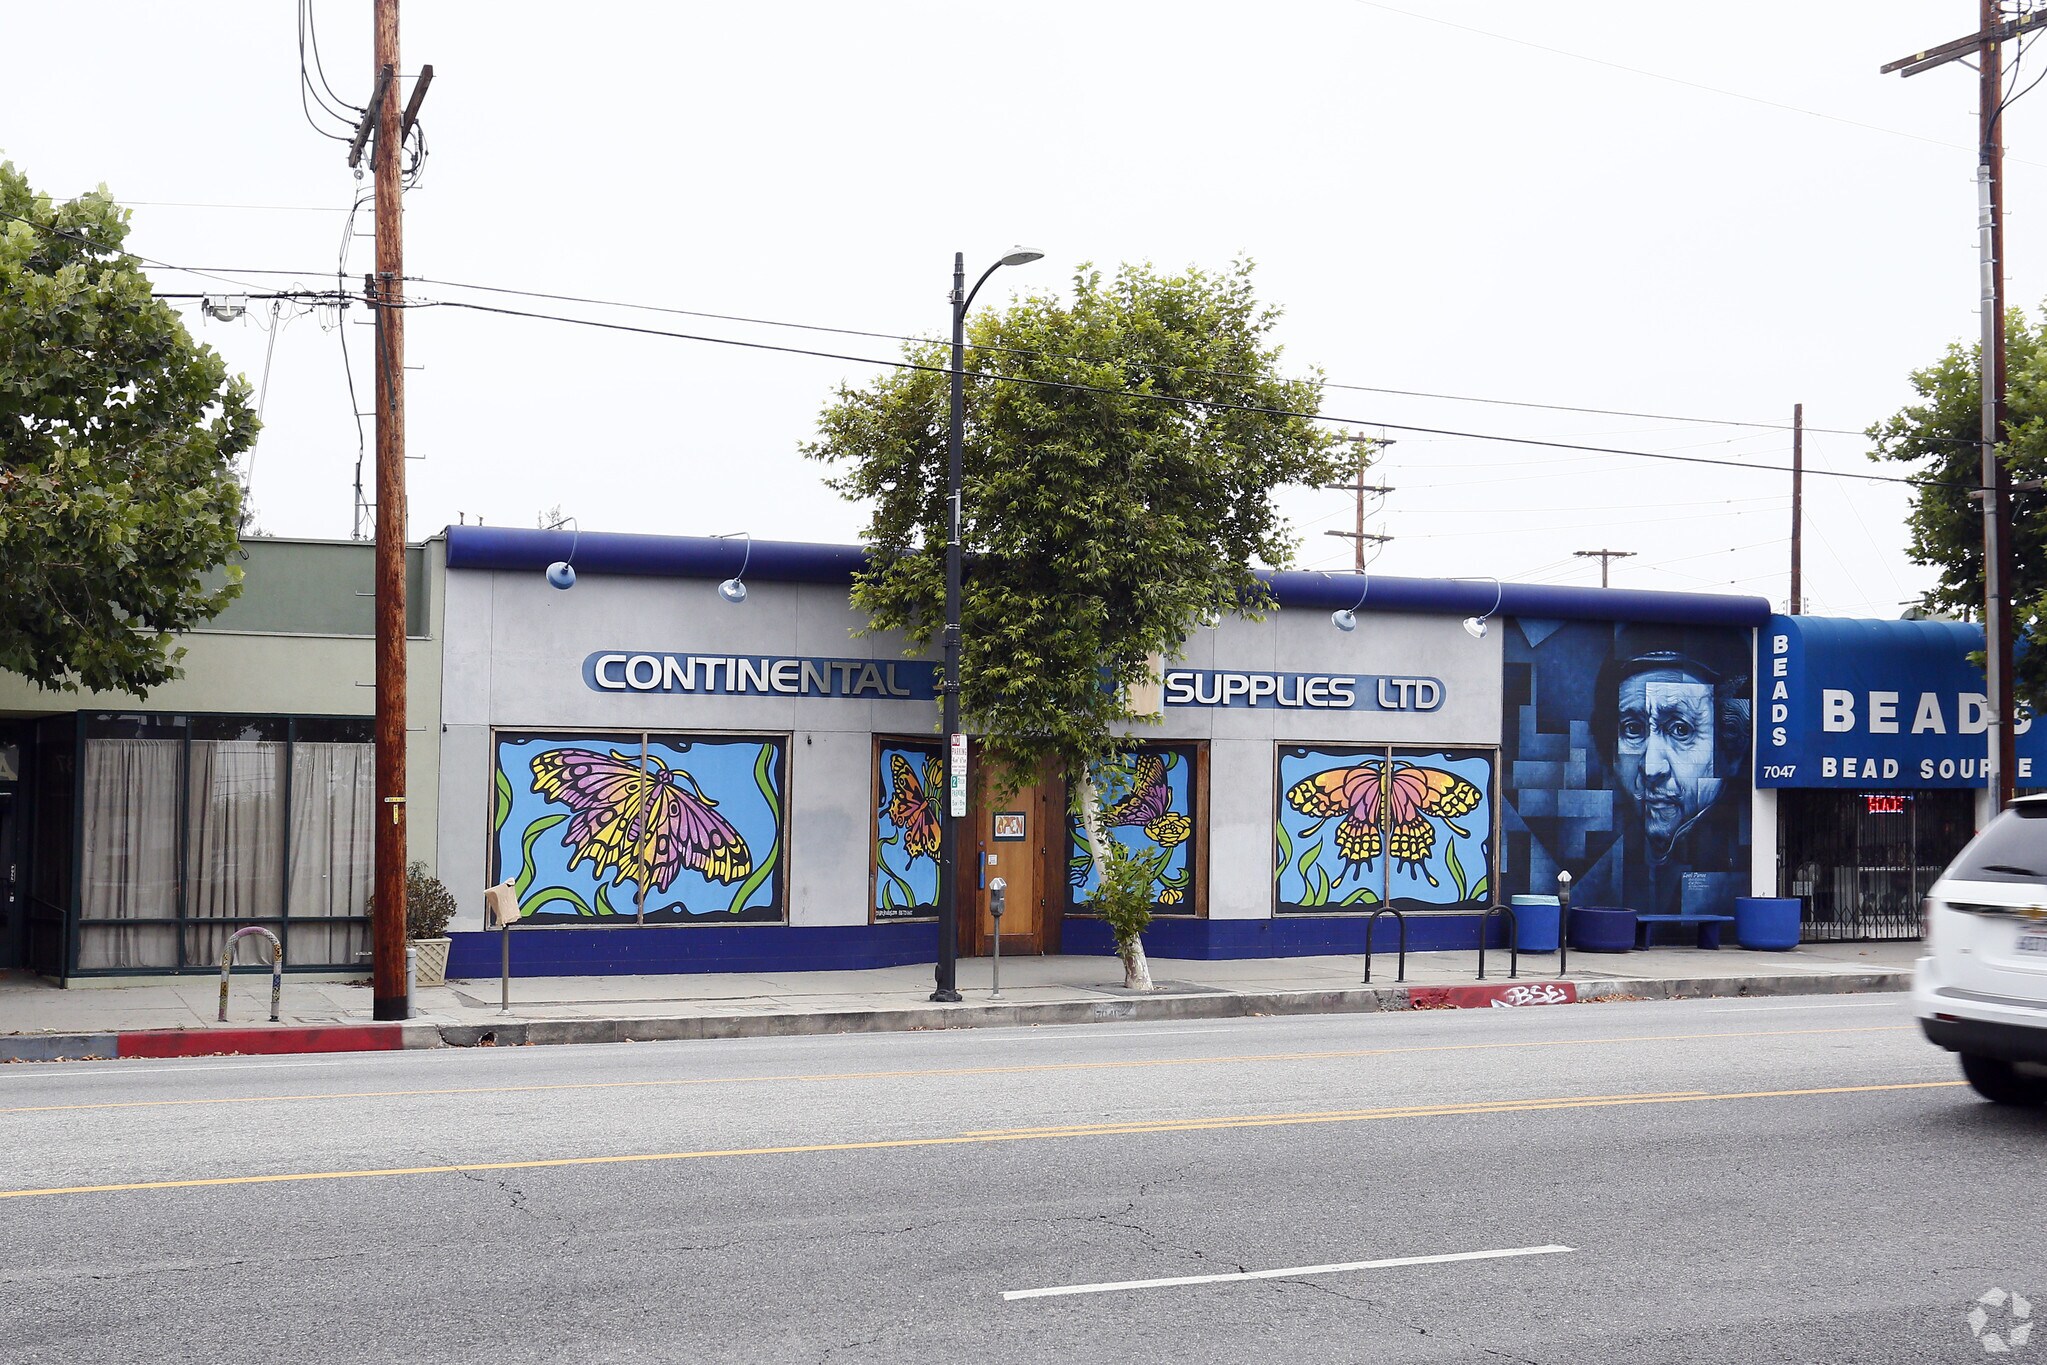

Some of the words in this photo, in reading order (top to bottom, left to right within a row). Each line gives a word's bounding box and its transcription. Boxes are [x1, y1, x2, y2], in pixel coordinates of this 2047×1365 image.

[594, 654, 910, 696] CONTINENTAL
[1166, 672, 1356, 708] SUPPLIES
[1377, 678, 1440, 709] LTD
[1772, 634, 1789, 747] BEADS
[1764, 765, 1797, 779] 7047
[1822, 757, 1899, 779] BEAD
[1920, 758, 2033, 779] SOURE
